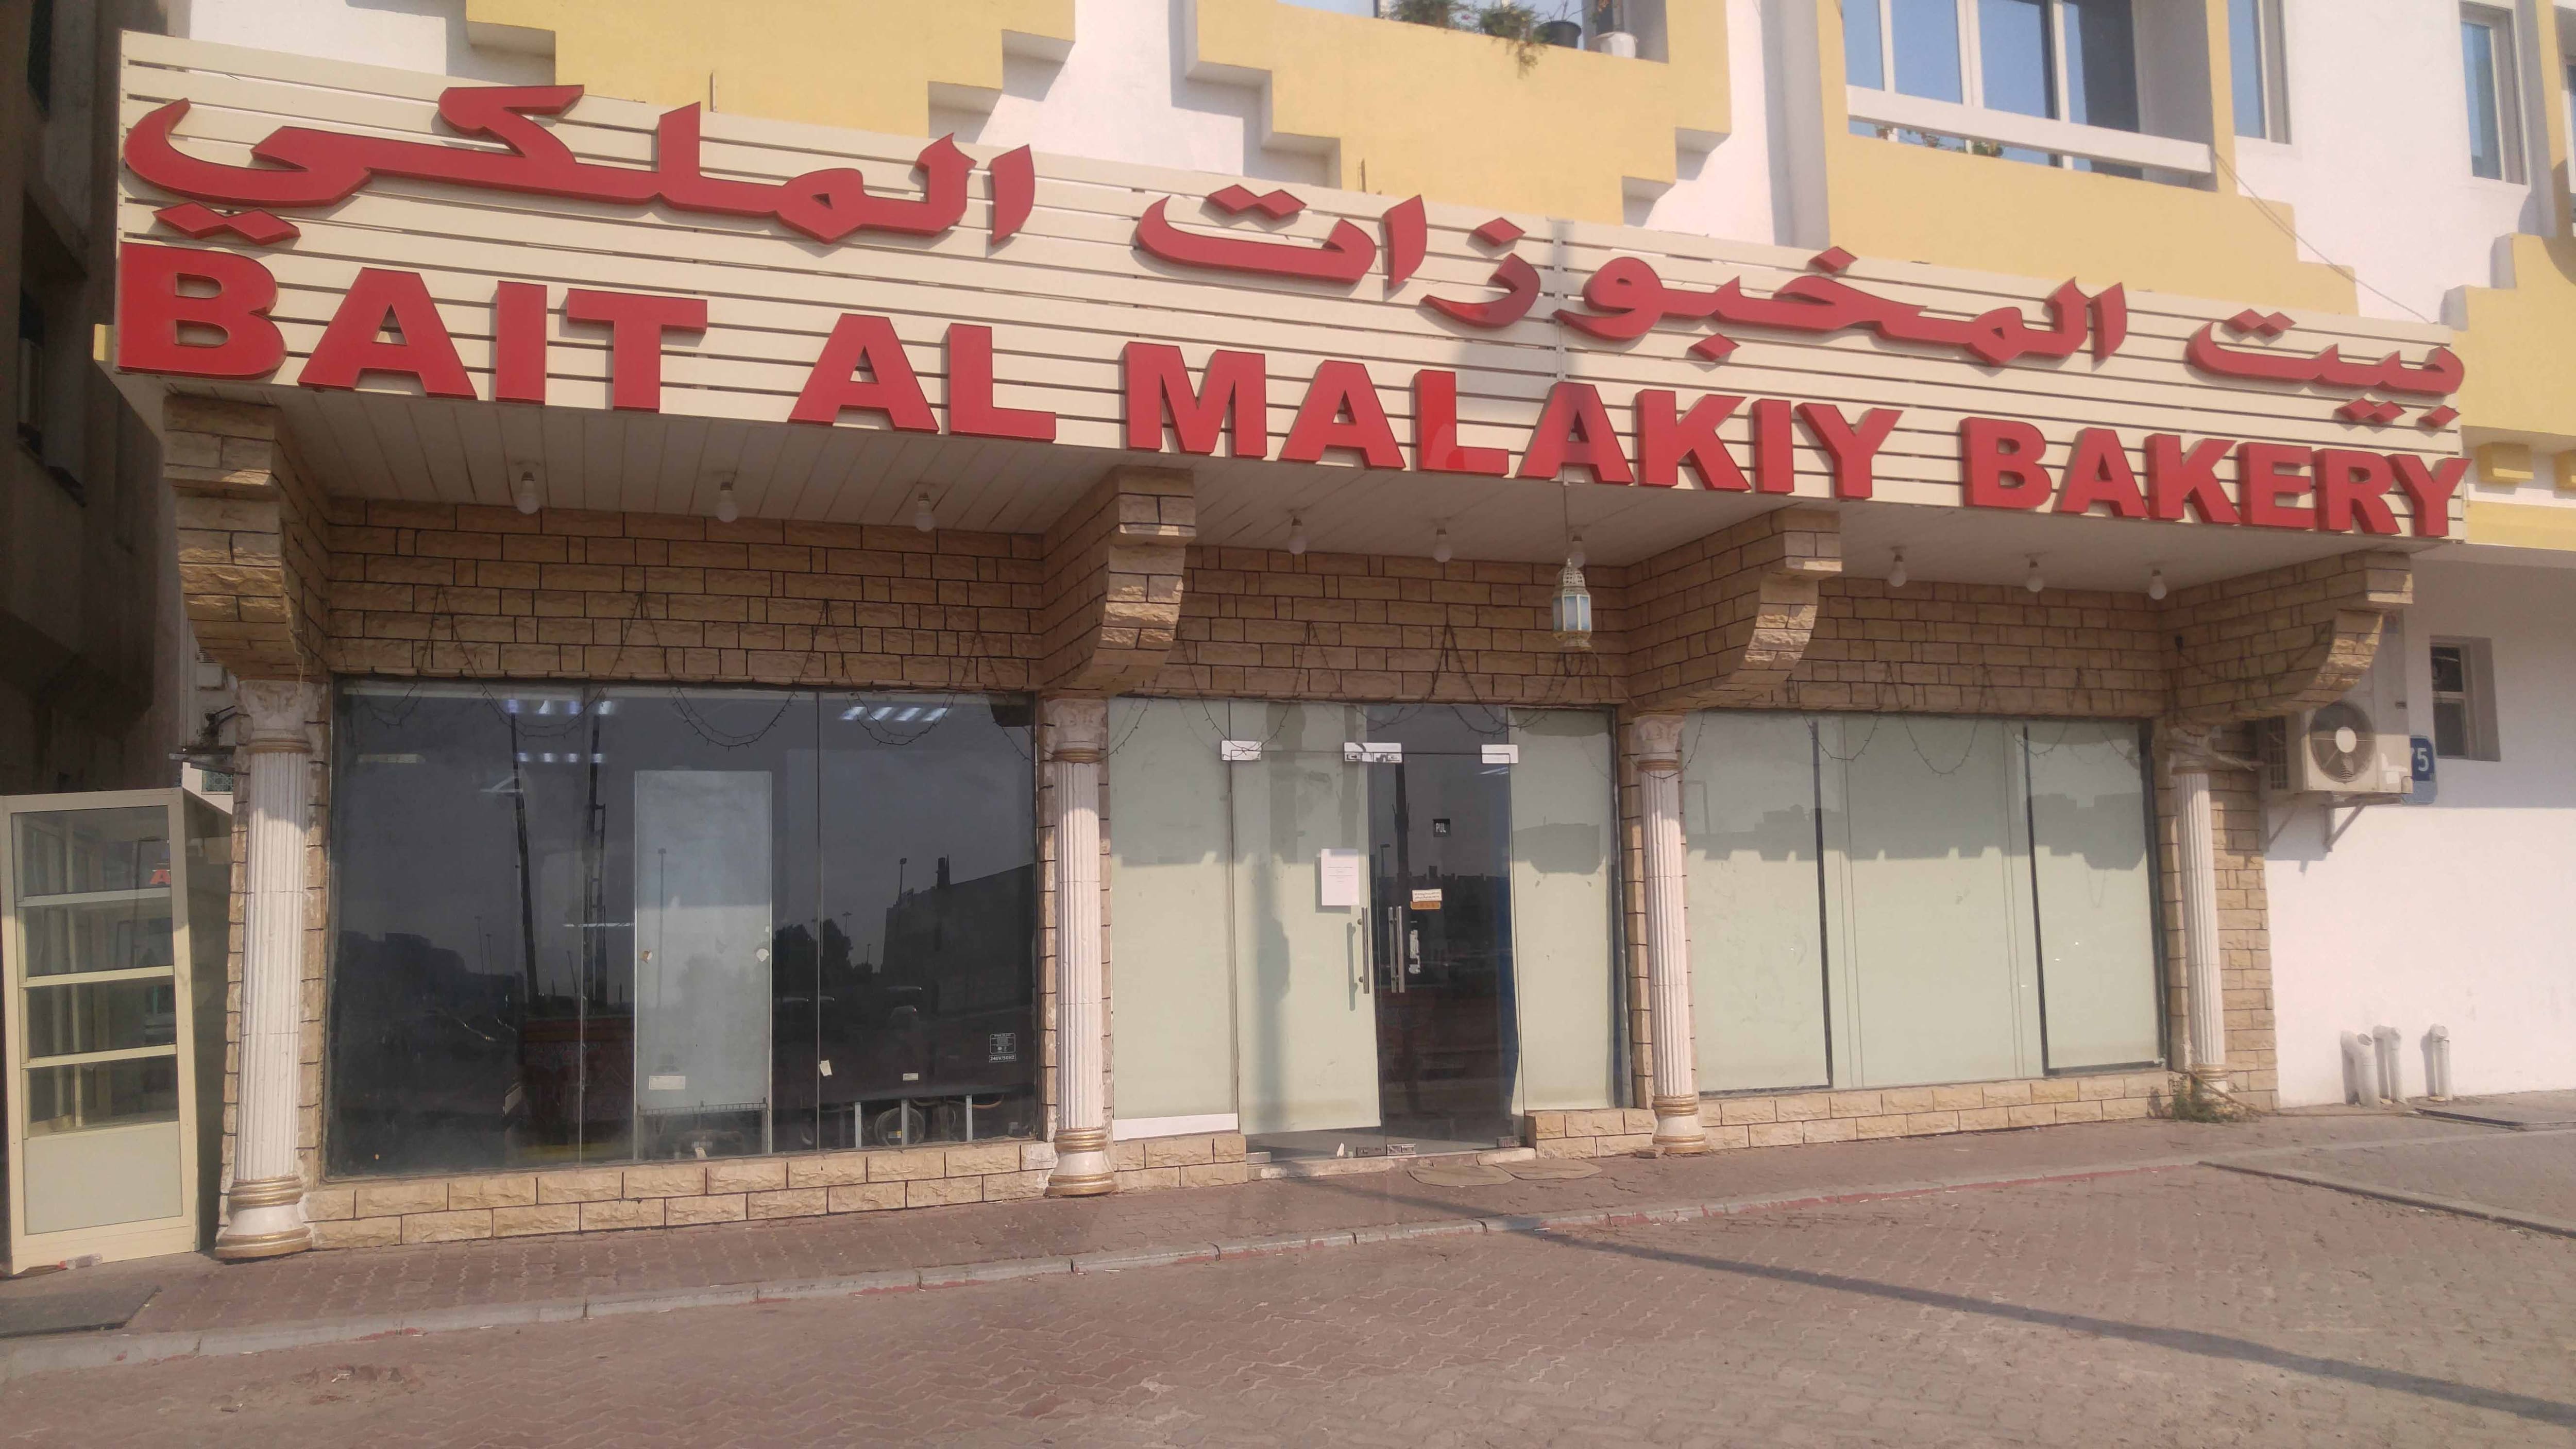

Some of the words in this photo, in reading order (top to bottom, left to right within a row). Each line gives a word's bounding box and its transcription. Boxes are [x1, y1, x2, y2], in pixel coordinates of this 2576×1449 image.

[123, 85, 1036, 246] الملكي
[1136, 184, 2128, 367] المخبوزات
[117, 242, 709, 413] BAIT
[789, 313, 1058, 442] AL
[1124, 341, 1902, 500] MALAKIY
[1960, 416, 2472, 537] BAKERY
[2186, 310, 2465, 427] بيت
